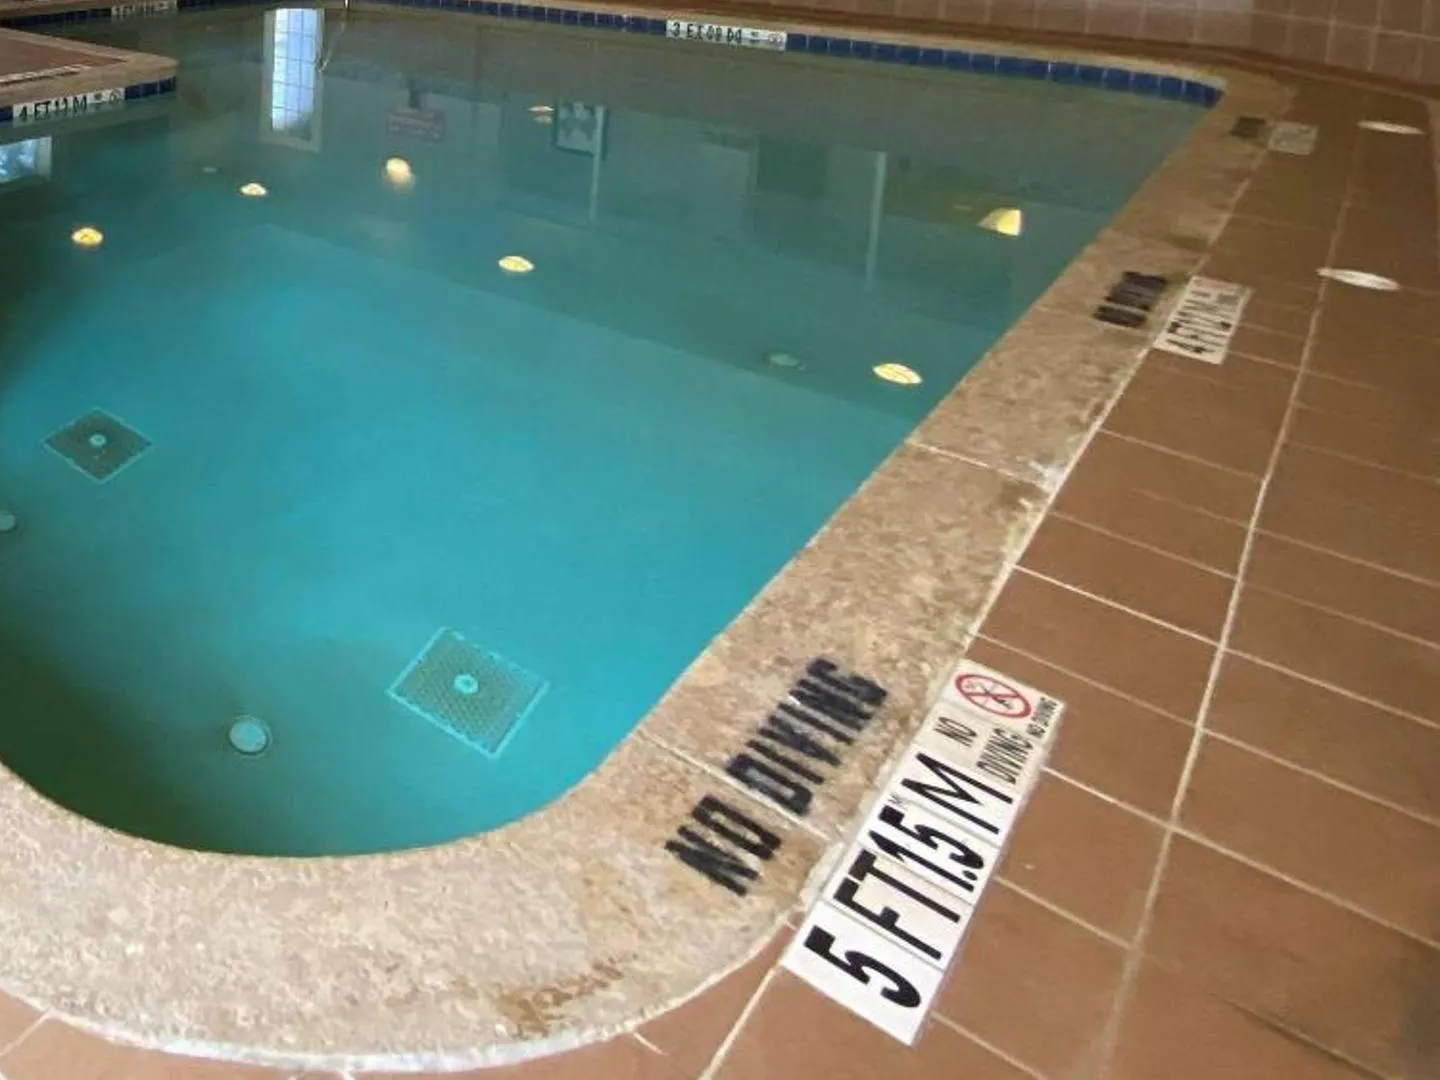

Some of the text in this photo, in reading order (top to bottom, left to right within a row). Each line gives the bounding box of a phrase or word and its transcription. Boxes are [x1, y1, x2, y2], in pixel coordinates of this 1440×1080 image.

[933, 716, 978, 748] NO
[976, 727, 1034, 785] DIVING
[664, 658, 887, 897] NO DIVING
[901, 752, 1014, 835] M
[833, 849, 961, 961] FT
[804, 925, 921, 1008] 5
